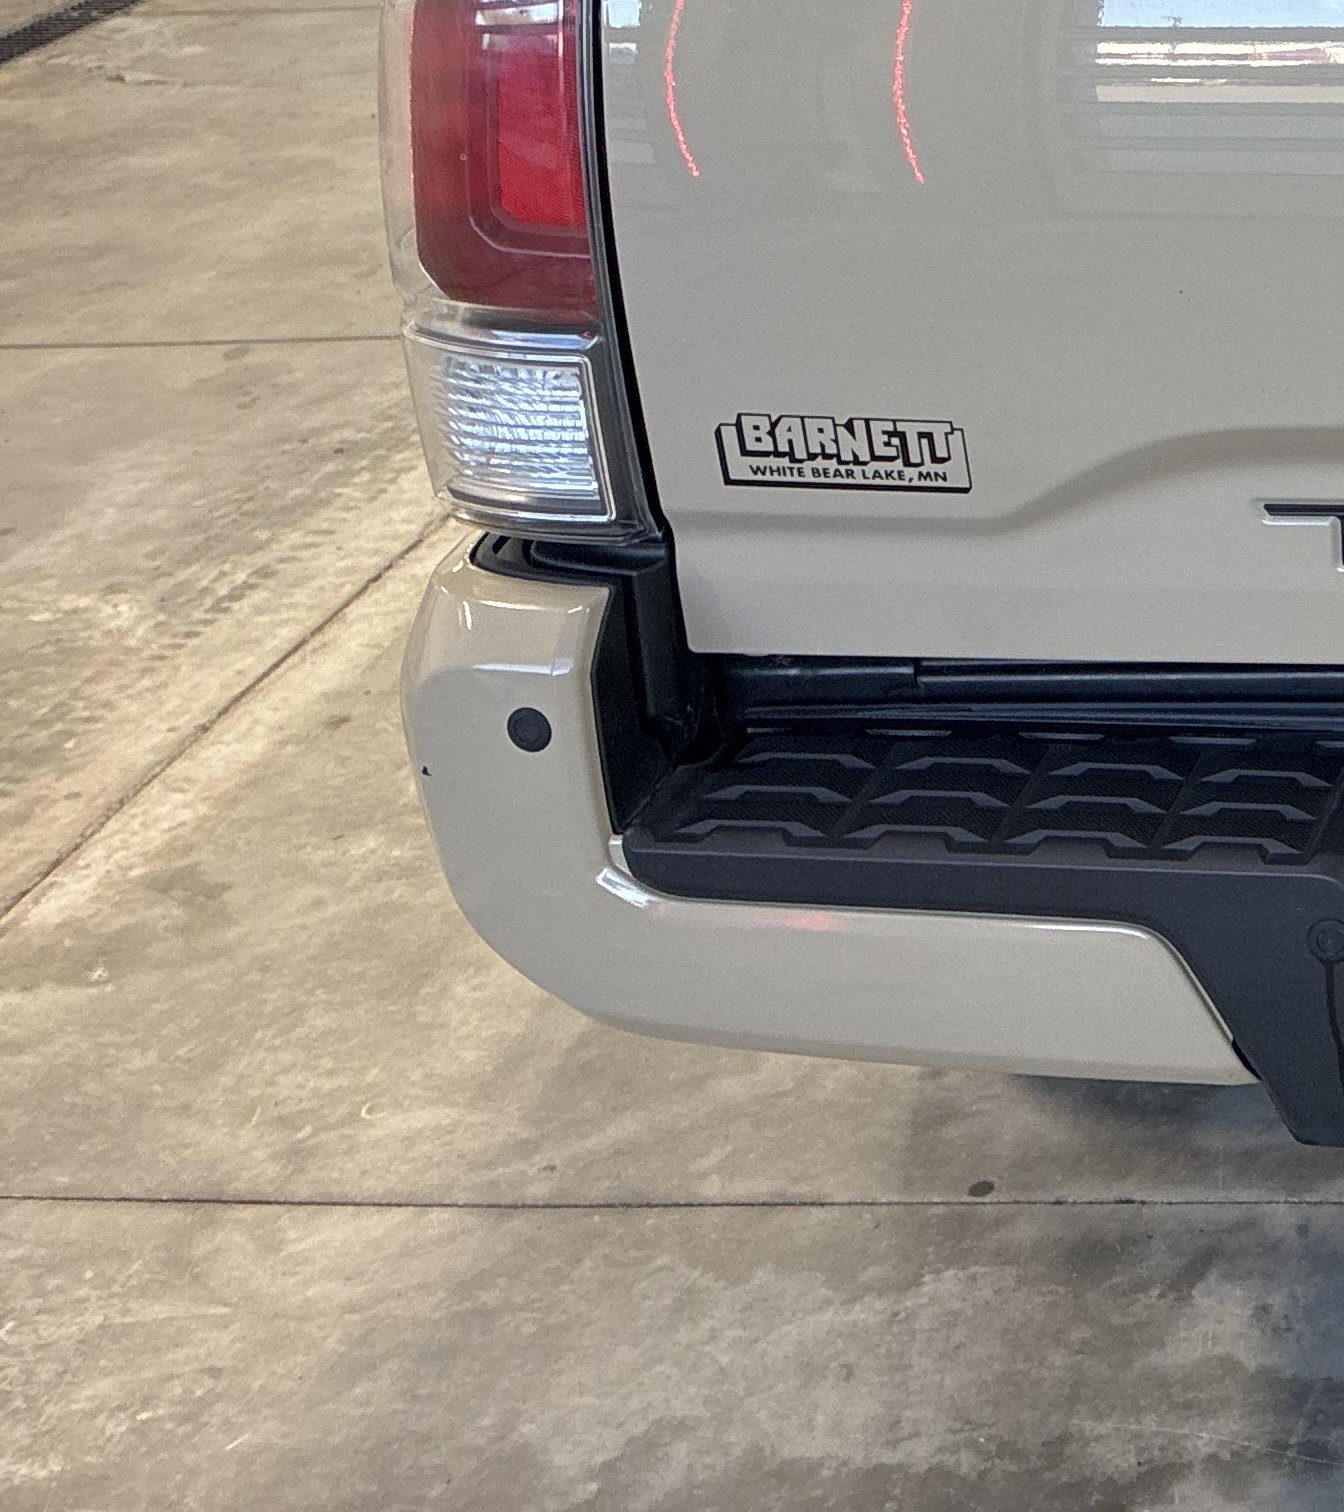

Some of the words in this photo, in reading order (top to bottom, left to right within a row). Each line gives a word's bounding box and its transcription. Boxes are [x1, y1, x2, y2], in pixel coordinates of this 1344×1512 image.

[736, 412, 954, 467] BARNETT
[749, 464, 805, 478] WHITE
[811, 467, 856, 480] BEAR
[862, 469, 915, 483] LAKE,
[917, 471, 948, 483] MN
